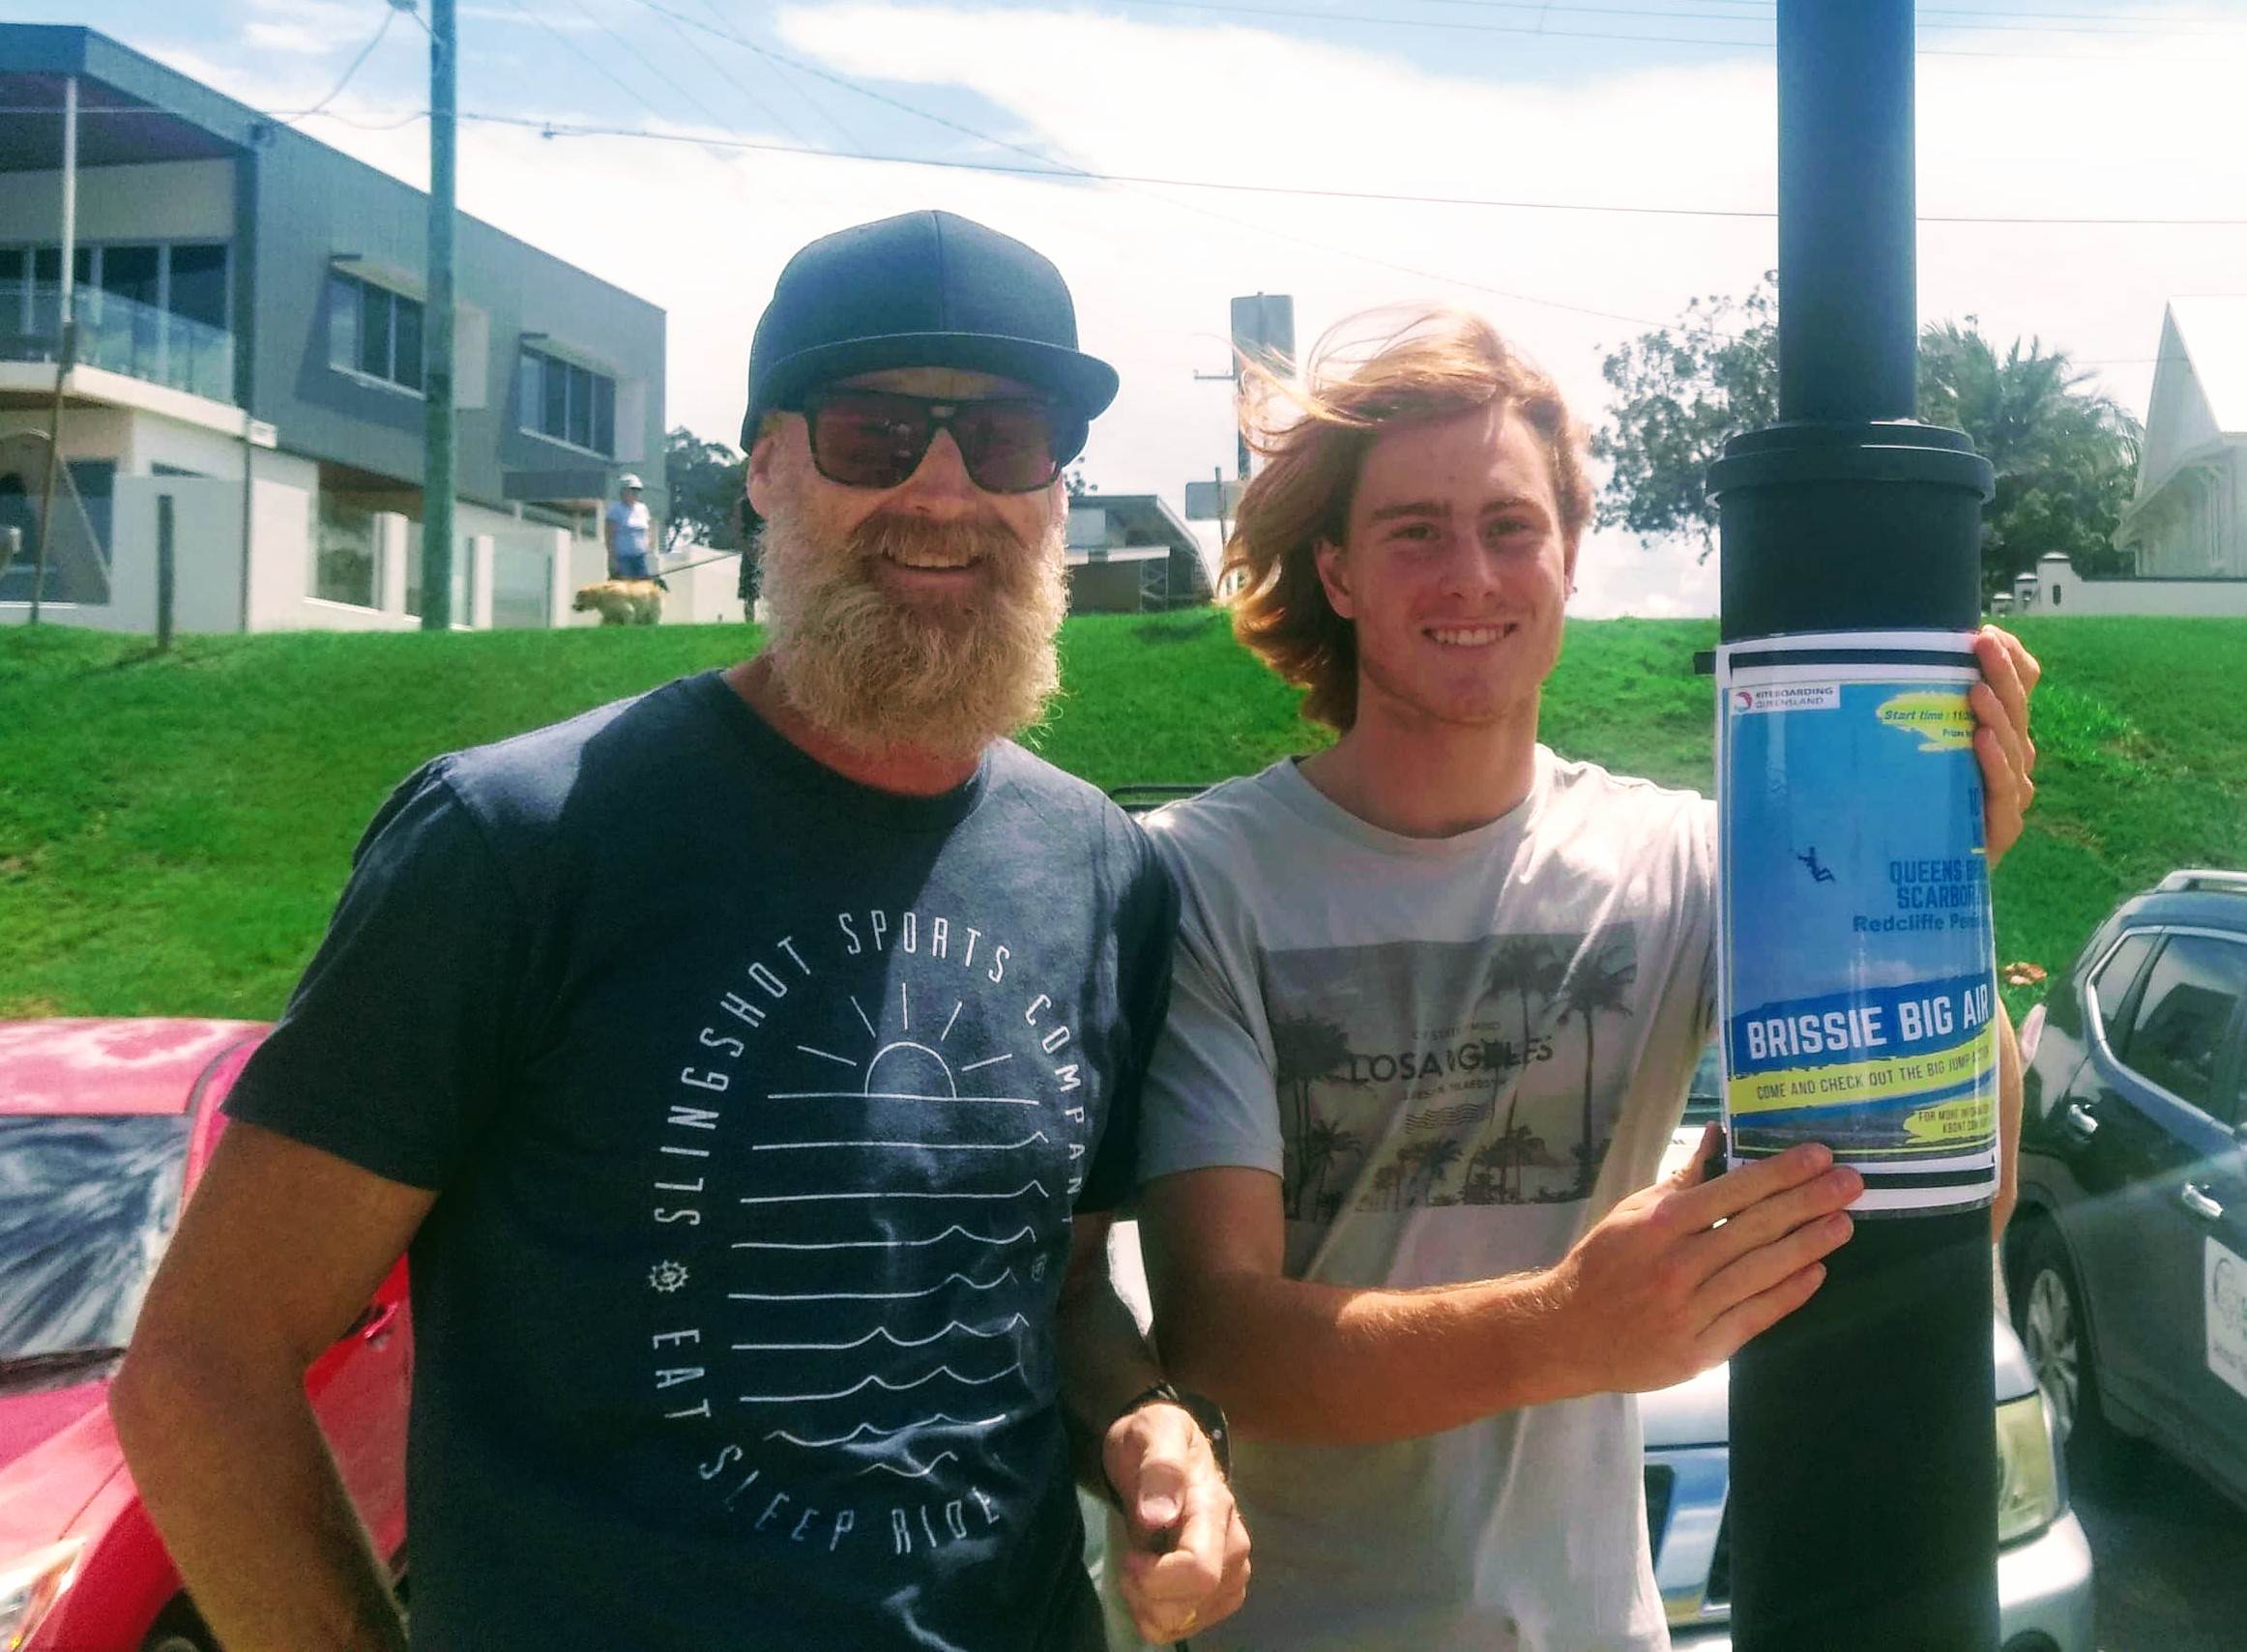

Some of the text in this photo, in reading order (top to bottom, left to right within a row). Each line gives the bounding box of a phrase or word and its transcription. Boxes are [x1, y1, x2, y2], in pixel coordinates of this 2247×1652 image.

[1884, 709, 1916, 721] Start
[1919, 709, 1943, 720] time
[1889, 858, 1962, 884] QUEENS
[1853, 913, 1943, 932] Redcliffe
[1747, 983, 1990, 1060] BRISSIE BIG AIR
[654, 936, 811, 1226] SLINGSHOT
[838, 910, 1011, 984] SPORTS
[1757, 1082, 1785, 1100] COME
[1791, 1079, 1816, 1095] AND
[1821, 1074, 1863, 1092] CHECK
[1869, 1069, 1894, 1087] OUT
[1899, 1065, 1923, 1082] THE
[1926, 1059, 1945, 1077] BIG
[653, 1328, 1001, 1555] EAT SLEEP RIDE
